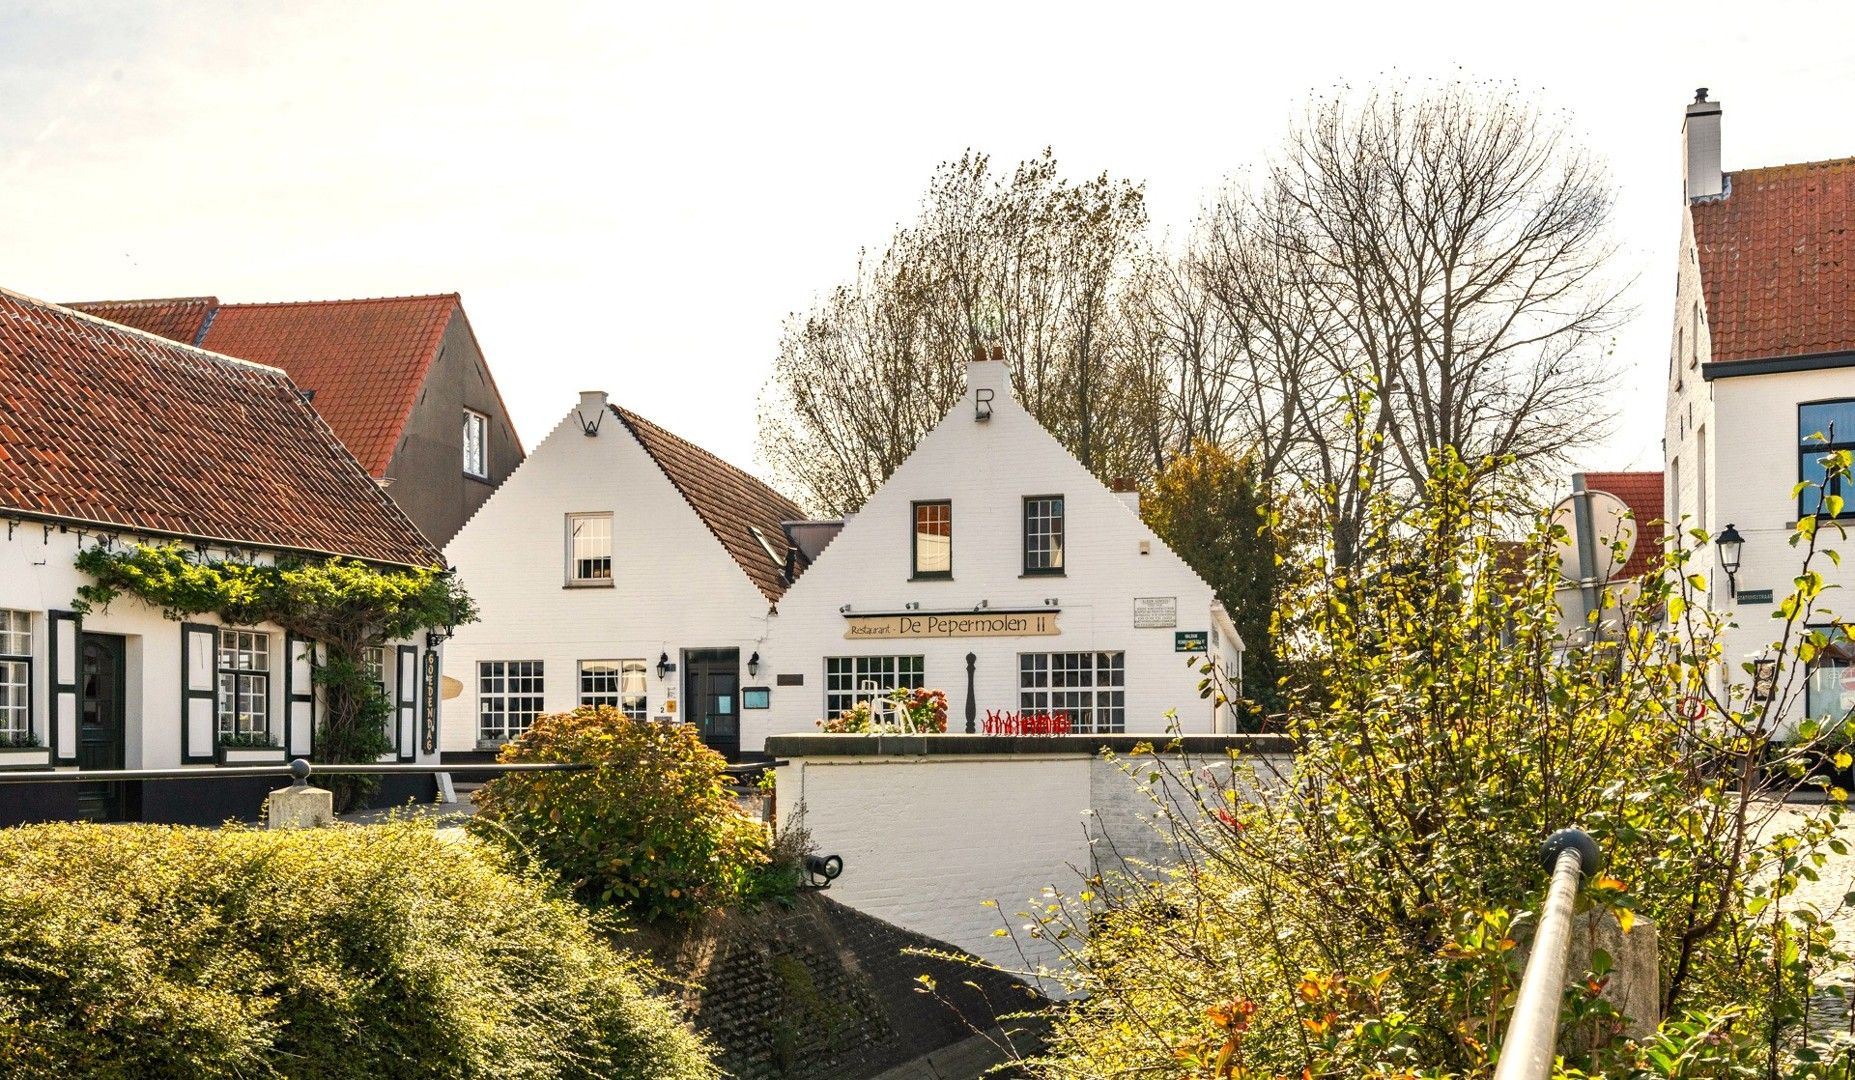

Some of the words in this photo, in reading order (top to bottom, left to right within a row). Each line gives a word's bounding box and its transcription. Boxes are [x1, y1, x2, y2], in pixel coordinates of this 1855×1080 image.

[578, 409, 604, 432] W
[851, 623, 891, 635] Restaurant
[900, 617, 921, 634] De
[928, 614, 1027, 637] Pepermolen
[426, 654, 434, 750] GOEDENDAG
